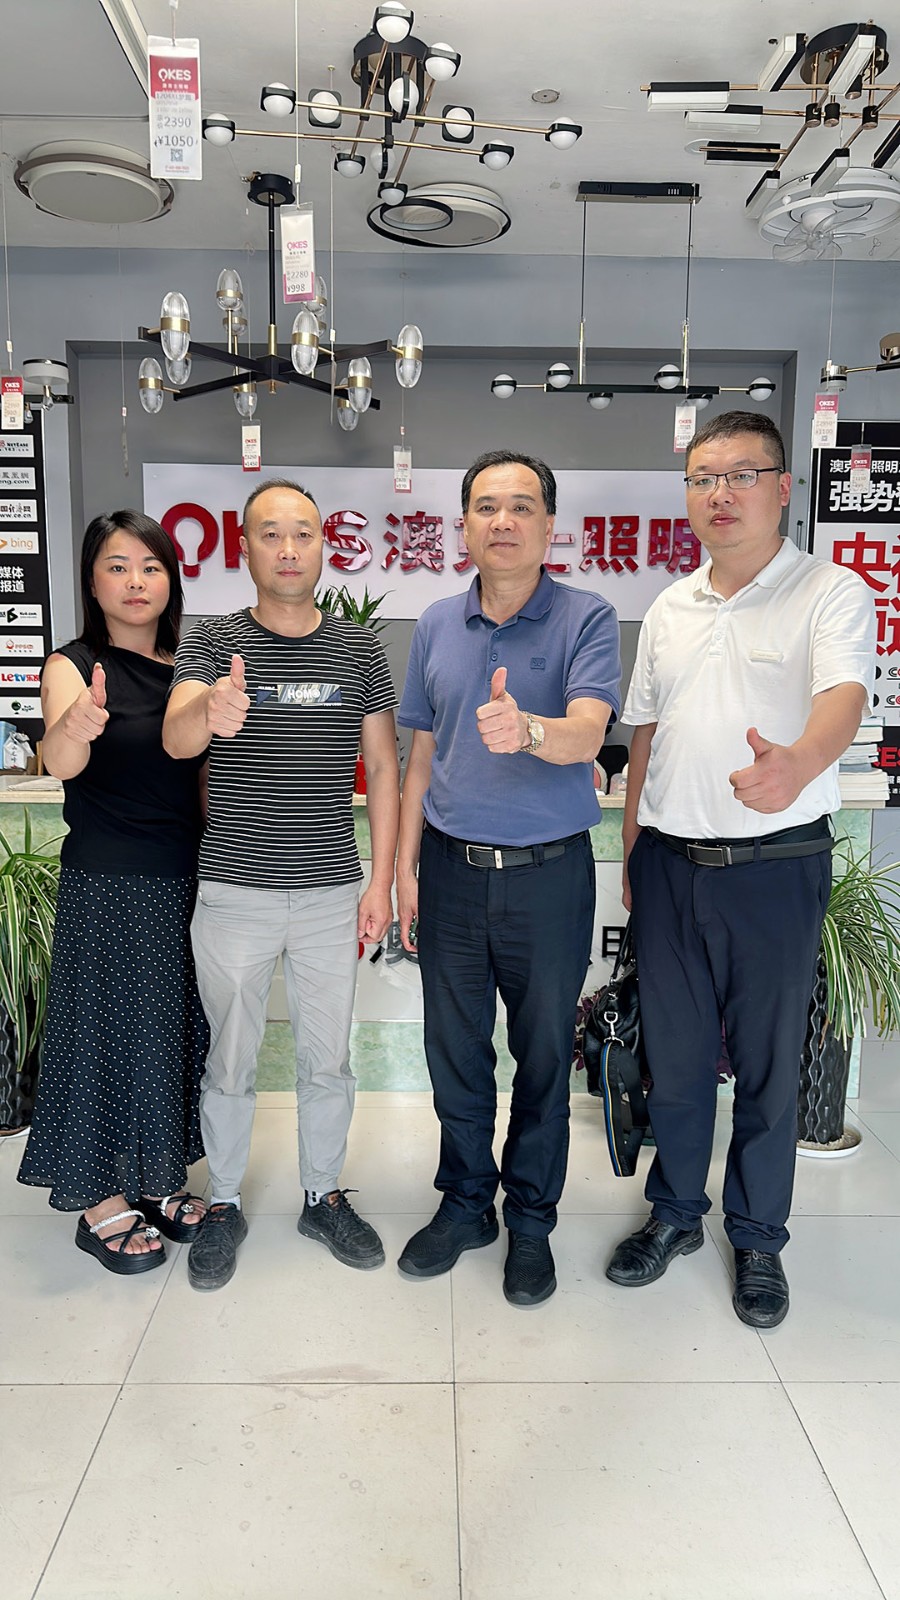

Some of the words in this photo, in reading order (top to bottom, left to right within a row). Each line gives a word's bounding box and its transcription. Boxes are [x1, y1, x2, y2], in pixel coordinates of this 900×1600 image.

[158, 68, 192, 81] OKES
[164, 117, 191, 128] 2390
[287, 241, 308, 251] OKES
[829, 480, 900, 512] 强势
[10, 537, 33, 550] bing
[833, 532, 900, 592] 央
[0, 566, 24, 579] 媒体
[0, 580, 25, 593] 报道
